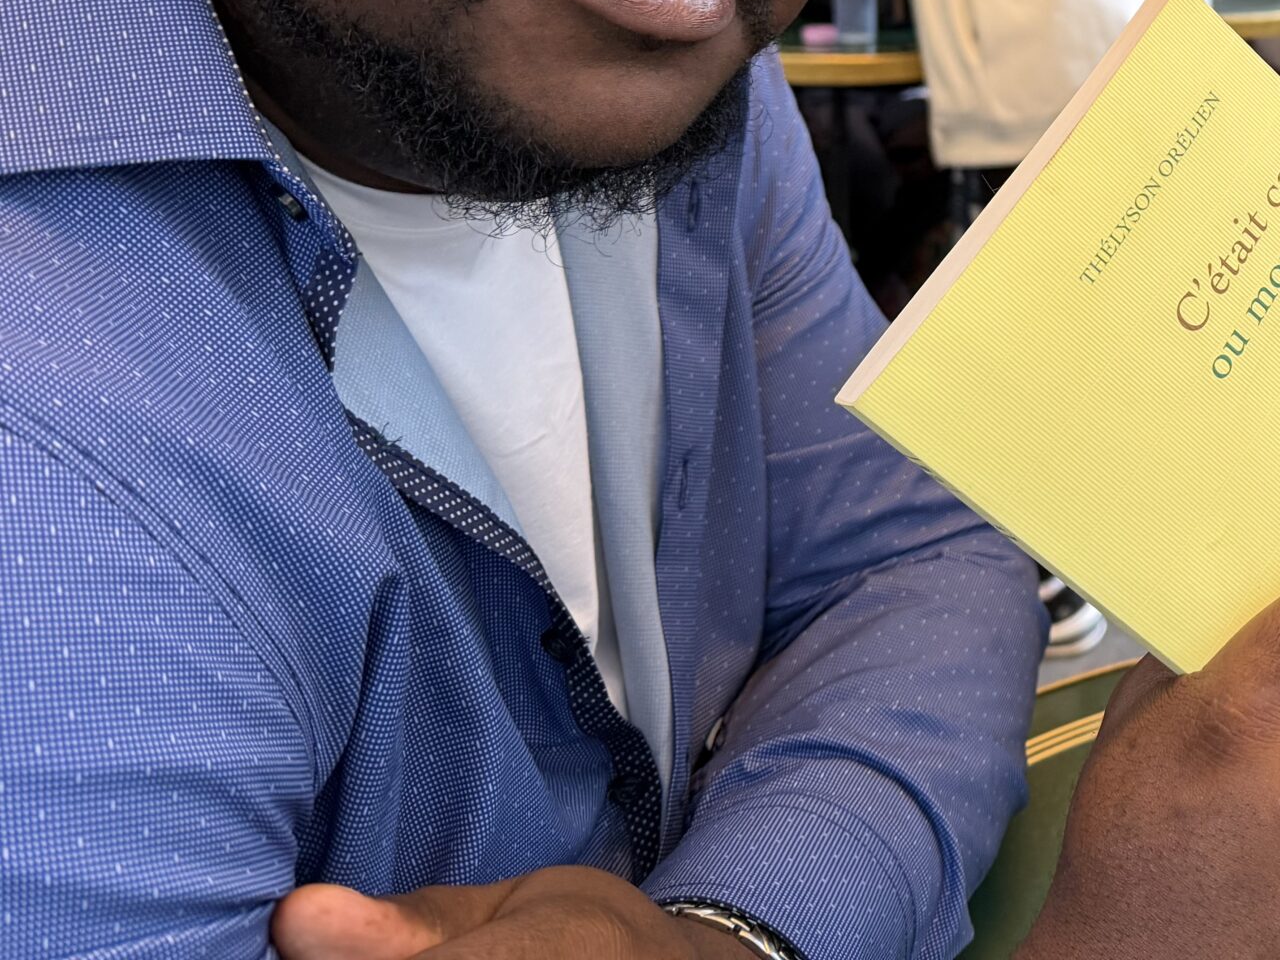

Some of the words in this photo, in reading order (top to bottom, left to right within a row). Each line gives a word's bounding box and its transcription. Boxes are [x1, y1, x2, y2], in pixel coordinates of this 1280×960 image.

[1079, 176, 1162, 285] THÉLYSON
[1158, 90, 1221, 178] ORÉLIEN
[1176, 210, 1269, 332] C'était
[1211, 329, 1250, 380] ou
